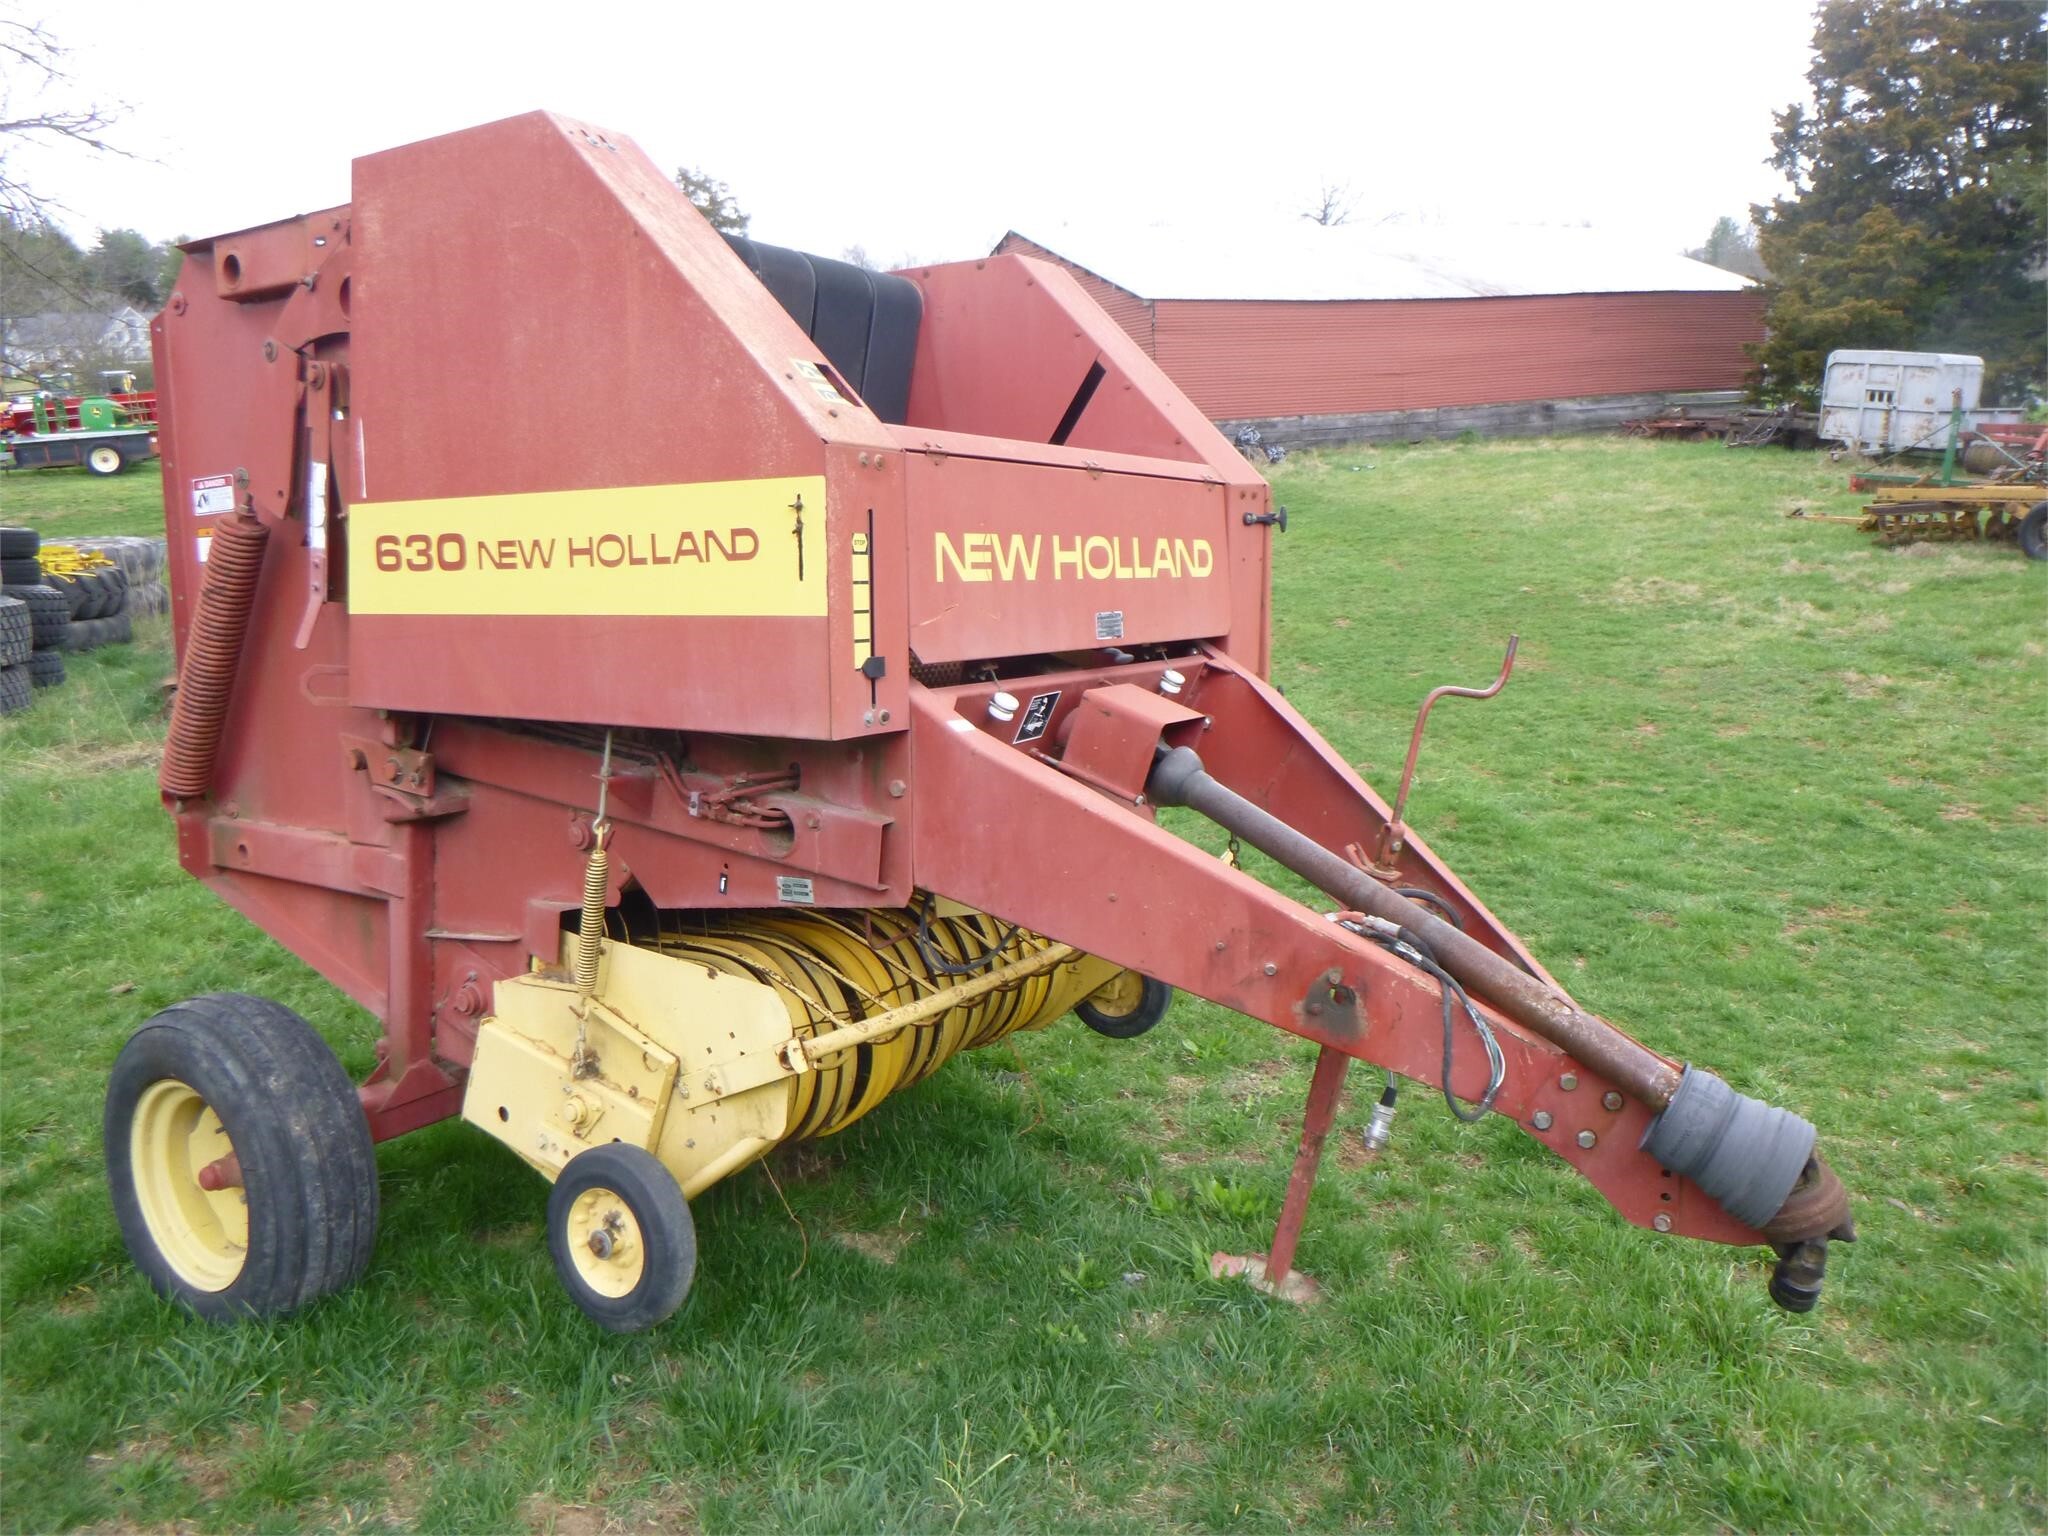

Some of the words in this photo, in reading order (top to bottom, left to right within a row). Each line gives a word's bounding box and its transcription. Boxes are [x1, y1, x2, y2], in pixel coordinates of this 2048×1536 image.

[376, 533, 467, 572] 630
[477, 538, 556, 570] NEW
[568, 527, 760, 568] HOLLAND
[935, 532, 1042, 582] NEW
[1053, 535, 1213, 580] HOLLAND
